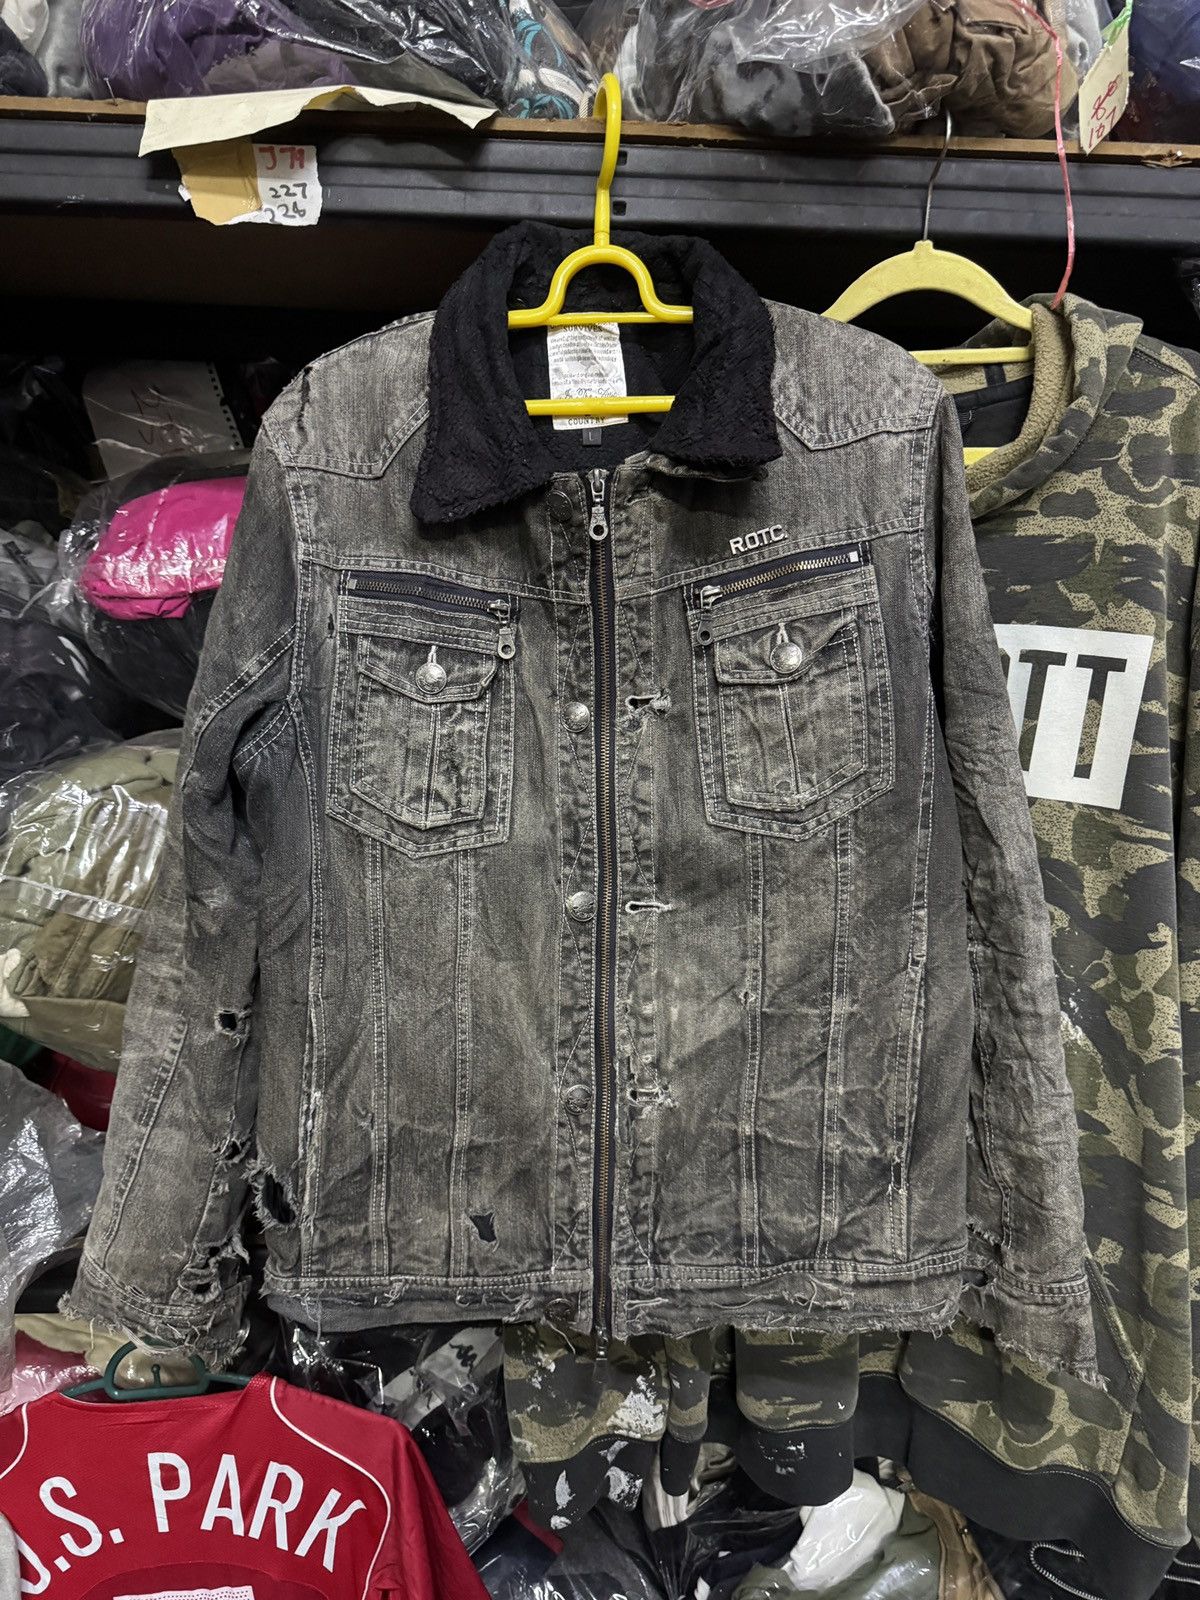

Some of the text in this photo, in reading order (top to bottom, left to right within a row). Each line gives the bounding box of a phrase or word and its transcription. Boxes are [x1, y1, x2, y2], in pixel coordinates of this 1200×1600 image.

[268, 182, 308, 199] 227
[567, 416, 606, 426] COUNTRY
[147, 1452, 367, 1573] PARK
